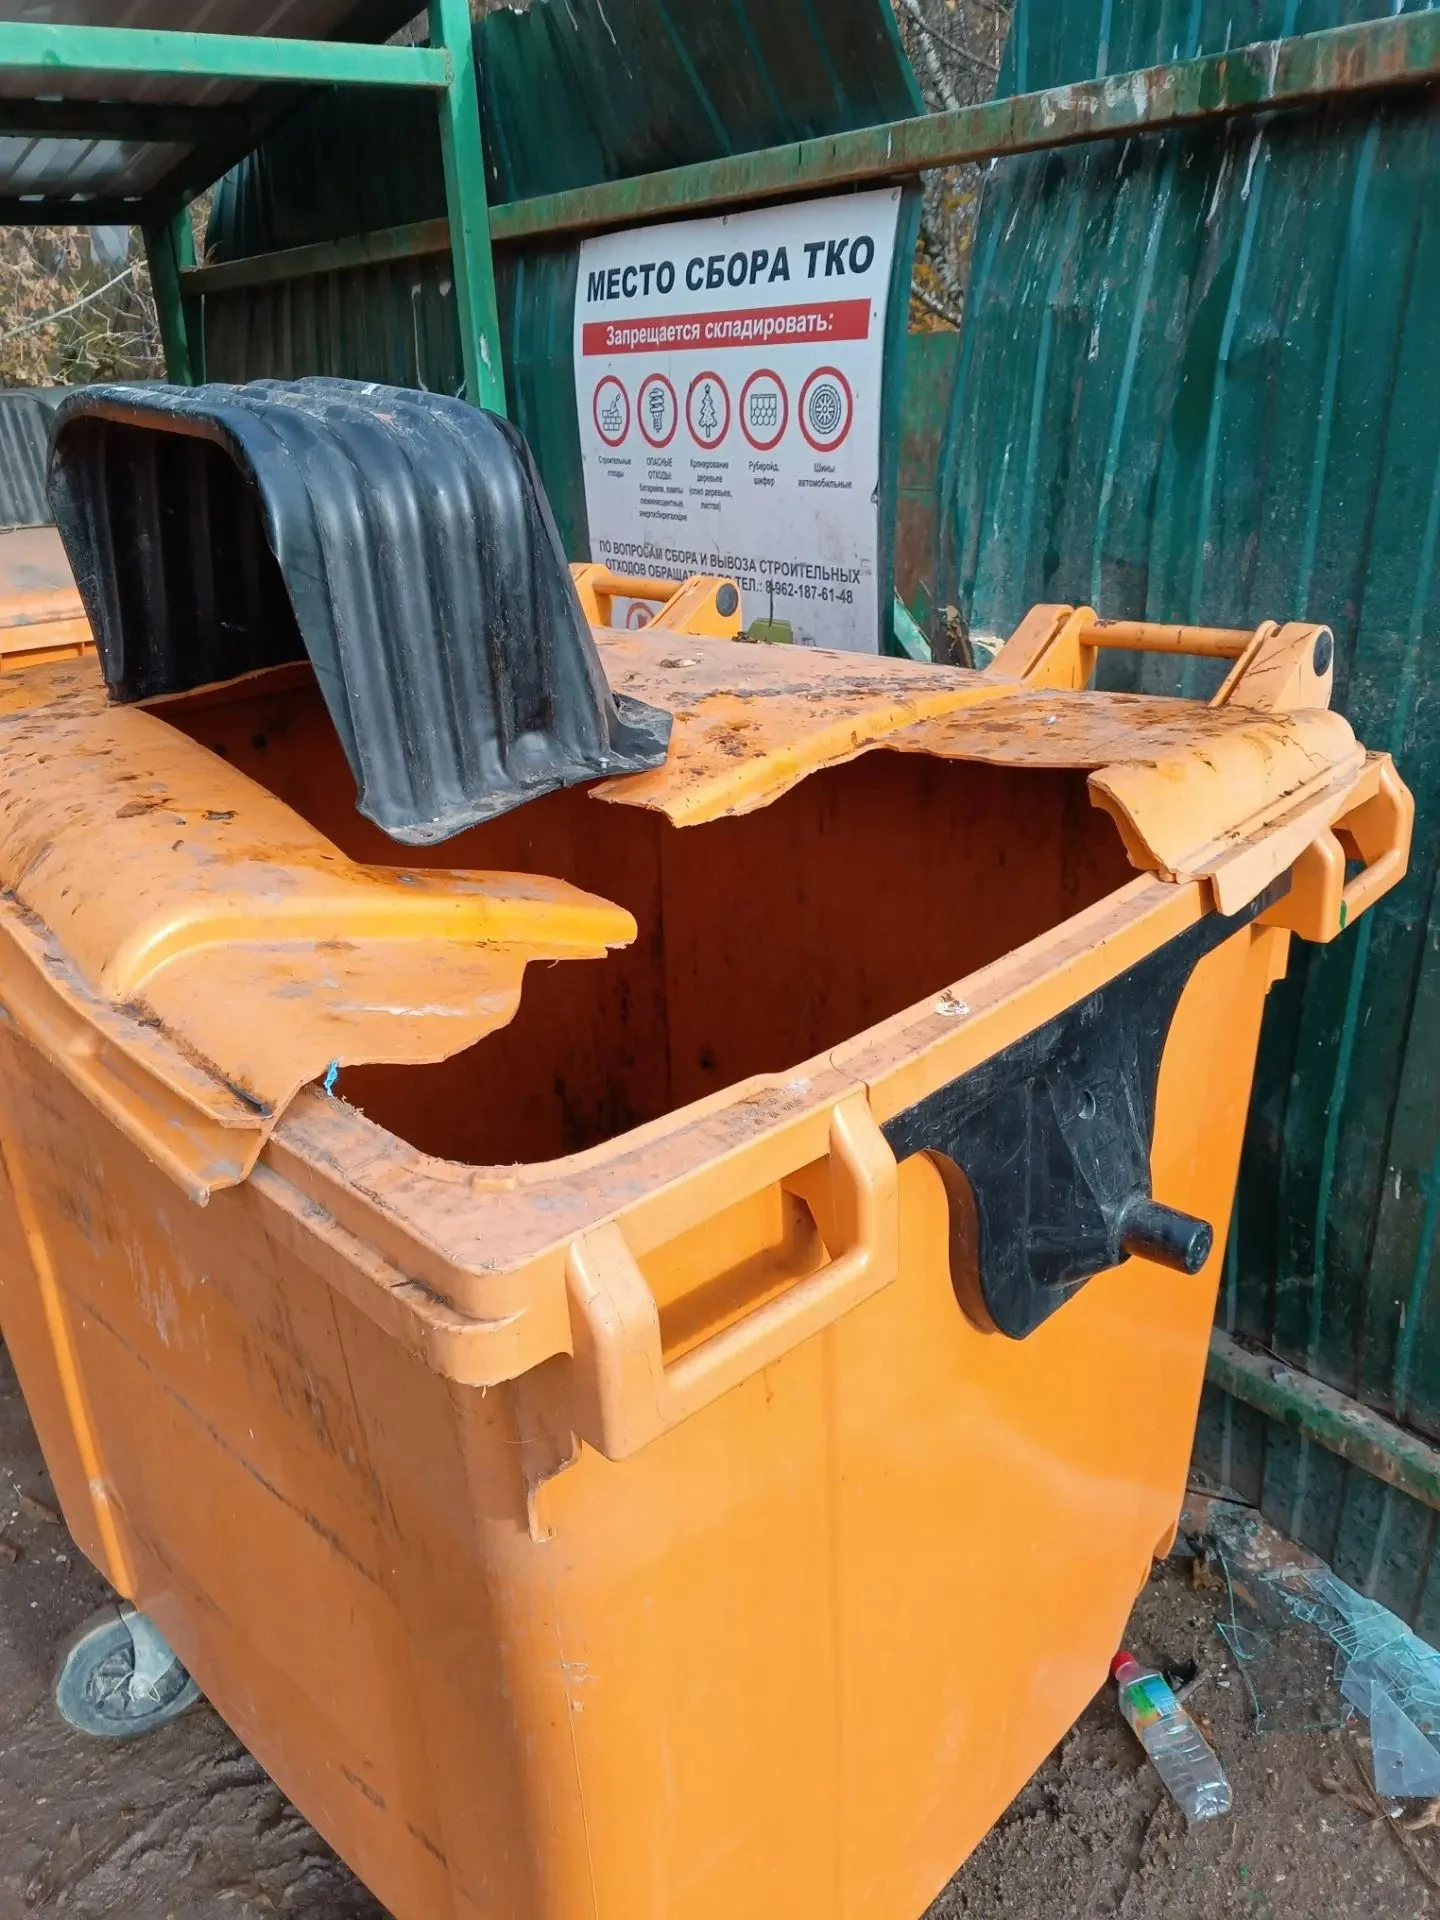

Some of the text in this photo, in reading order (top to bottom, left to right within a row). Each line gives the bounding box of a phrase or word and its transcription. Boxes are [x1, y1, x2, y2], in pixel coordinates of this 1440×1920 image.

[587, 236, 875, 303] МЕСТО СБОРА ТКО
[606, 312, 833, 347] Запрещается складировать:
[647, 457, 672, 467] ОПАСНЫЕ
[814, 463, 835, 473] Шины
[798, 478, 852, 488] автомобильные
[600, 540, 860, 584] ПО ВОПРОСАМ СБОРА И ВЫВОЗА СТРОИТЕЛЬНЫХ
[606, 558, 646, 576] ОТХОДОВ
[766, 580, 853, 604] 8-962-187-61-48
